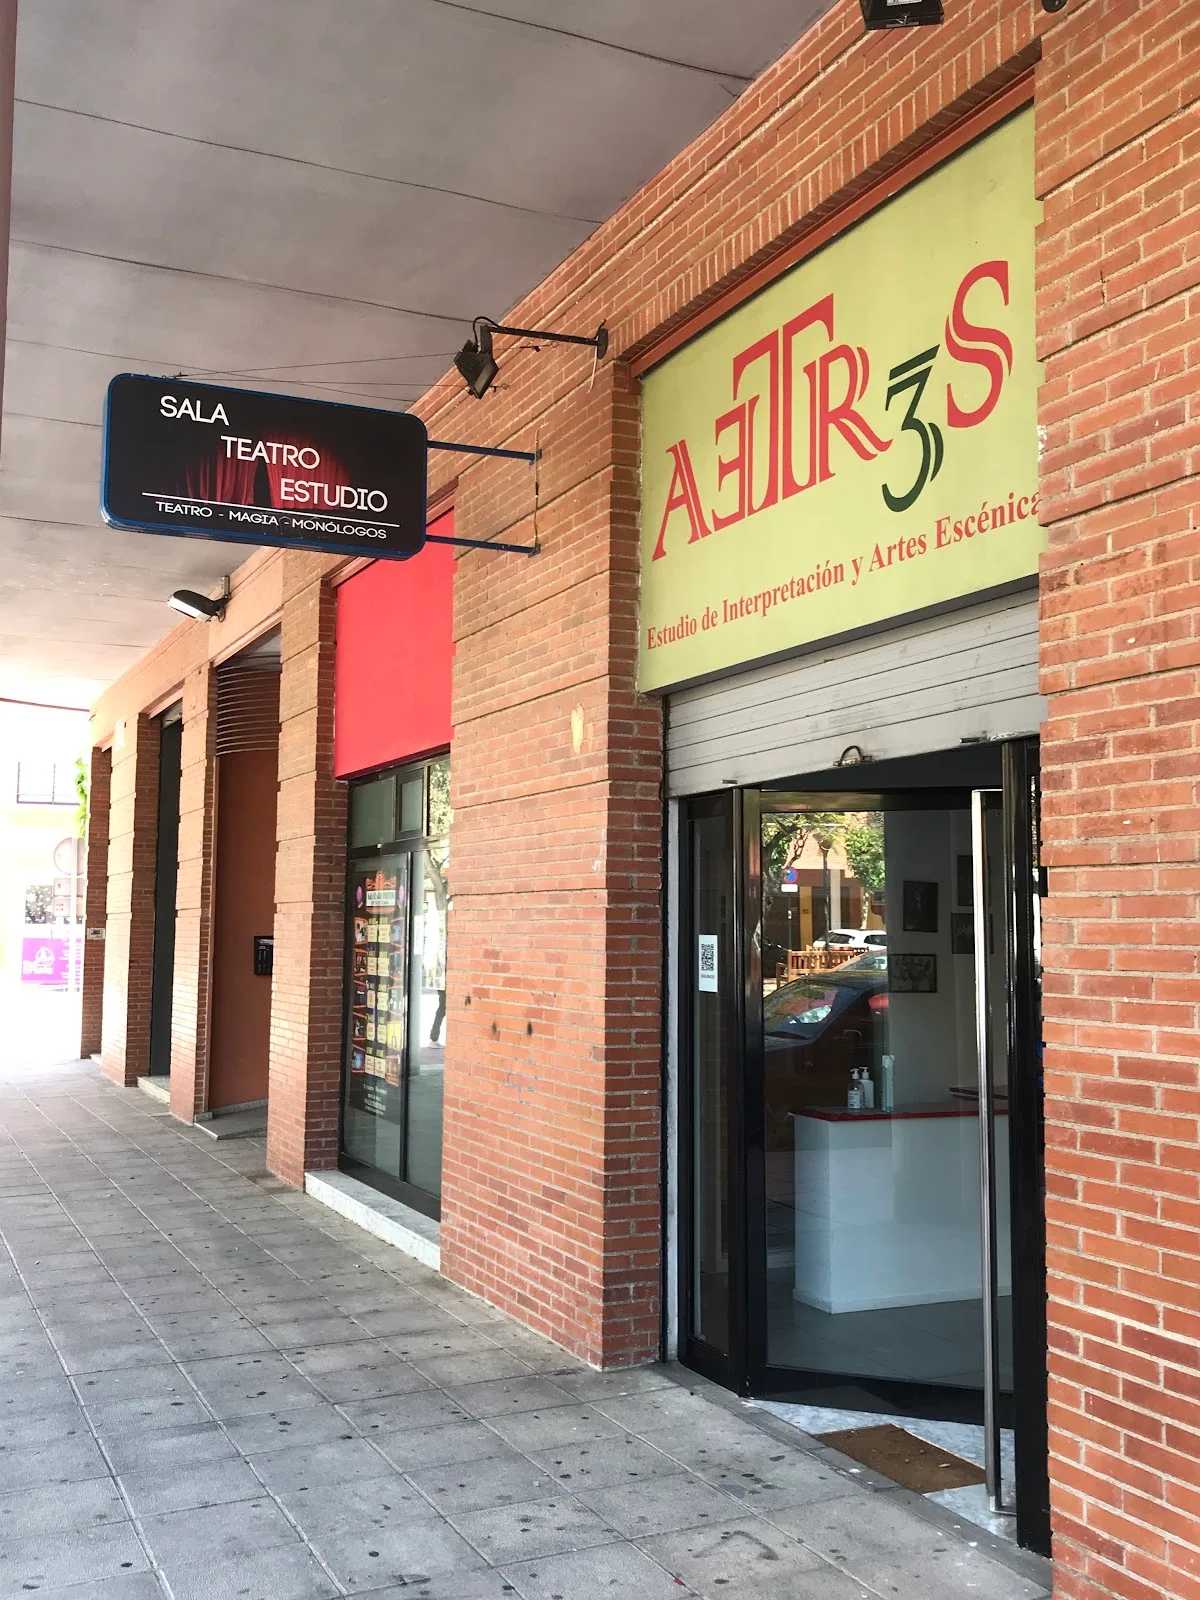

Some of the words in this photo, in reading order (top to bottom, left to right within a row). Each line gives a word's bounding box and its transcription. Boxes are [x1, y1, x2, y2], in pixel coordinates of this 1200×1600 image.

[160, 395, 229, 425] SALA
[221, 435, 320, 469] TEATRO
[280, 477, 388, 512] ESTUDIO
[155, 501, 213, 518] TEATRO
[228, 510, 279, 526] MAGIA
[292, 518, 387, 540] MONÓLOGOS
[646, 614, 697, 651] Estudio
[701, 606, 718, 632] de
[722, 559, 845, 625] Interpretación
[851, 556, 863, 586] y
[868, 536, 927, 573] Artes
